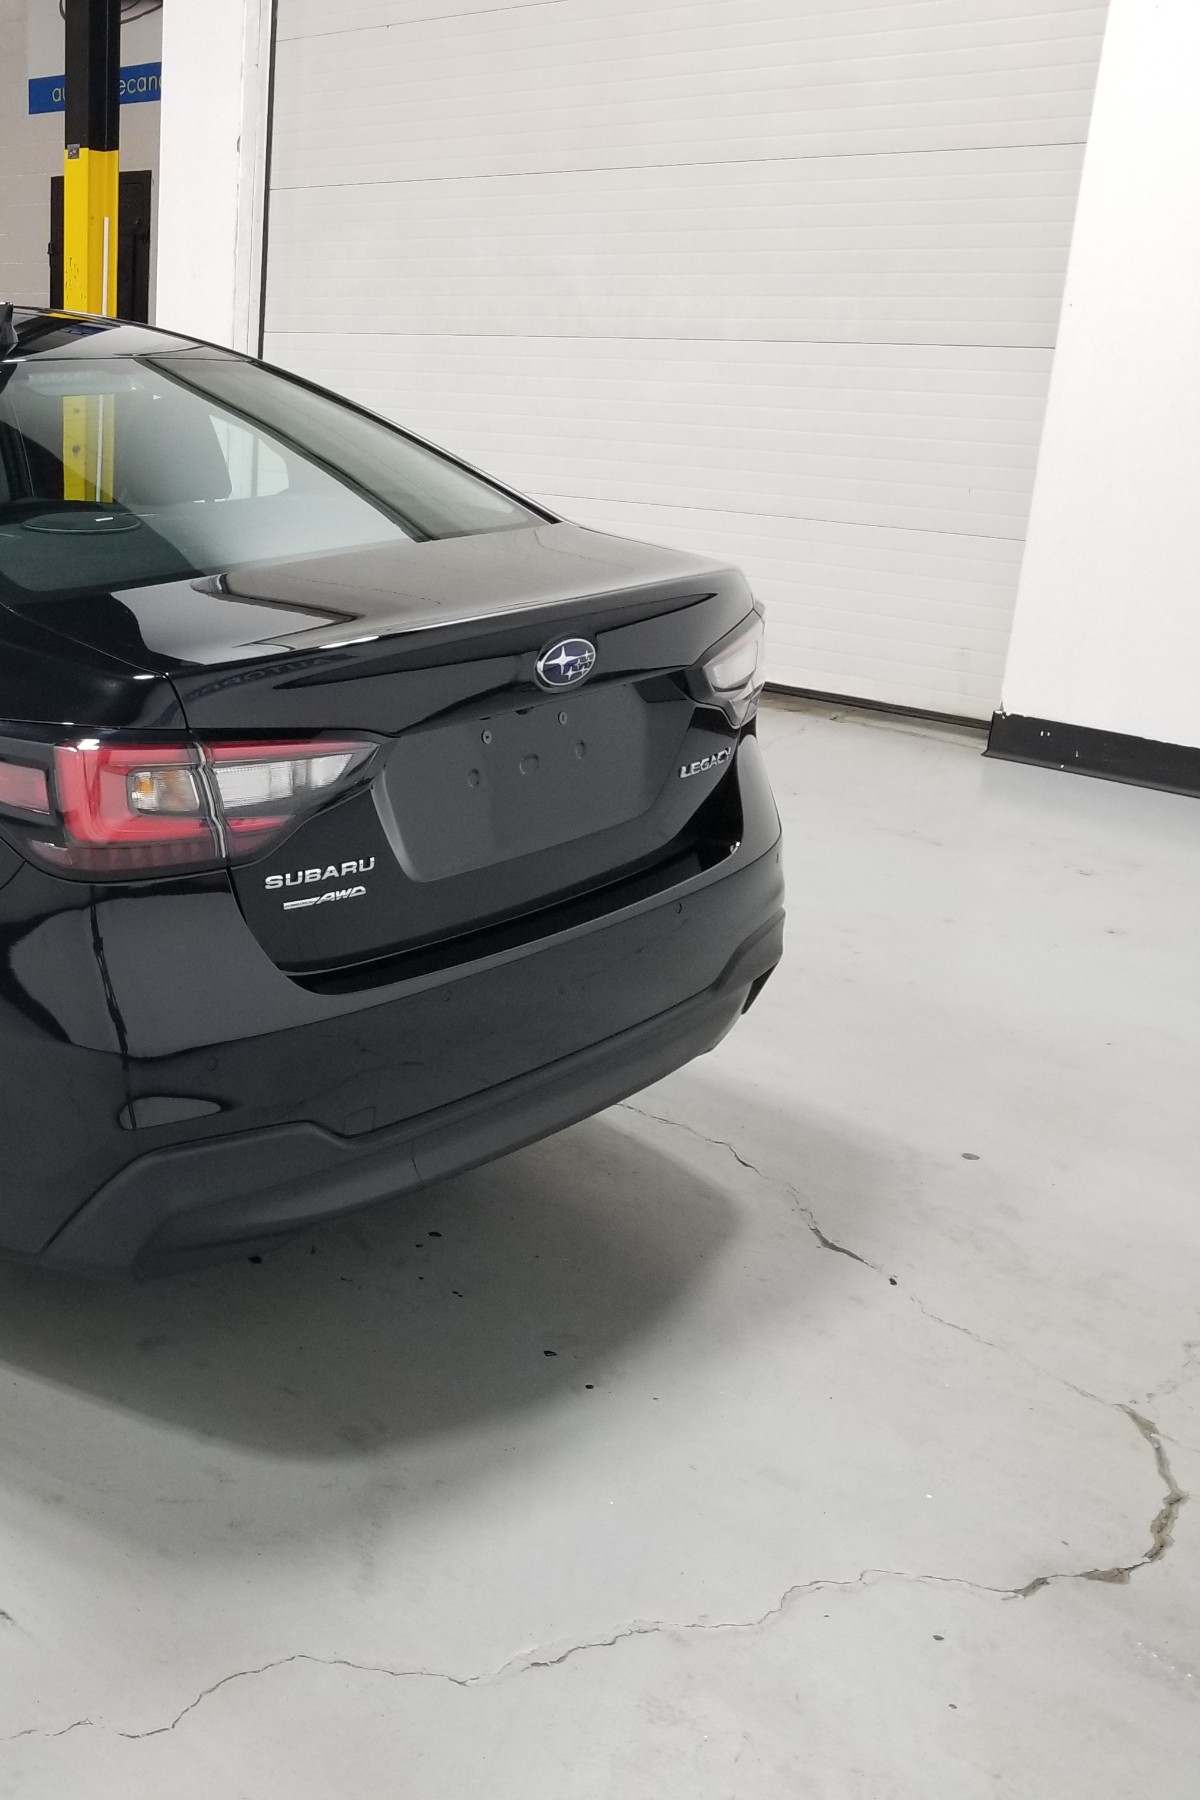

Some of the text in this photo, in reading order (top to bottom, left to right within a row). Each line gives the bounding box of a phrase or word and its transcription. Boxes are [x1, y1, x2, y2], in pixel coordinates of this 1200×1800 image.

[680, 747, 731, 778] LEGACY
[264, 856, 375, 889] SUBARU
[316, 885, 367, 905] AWD
